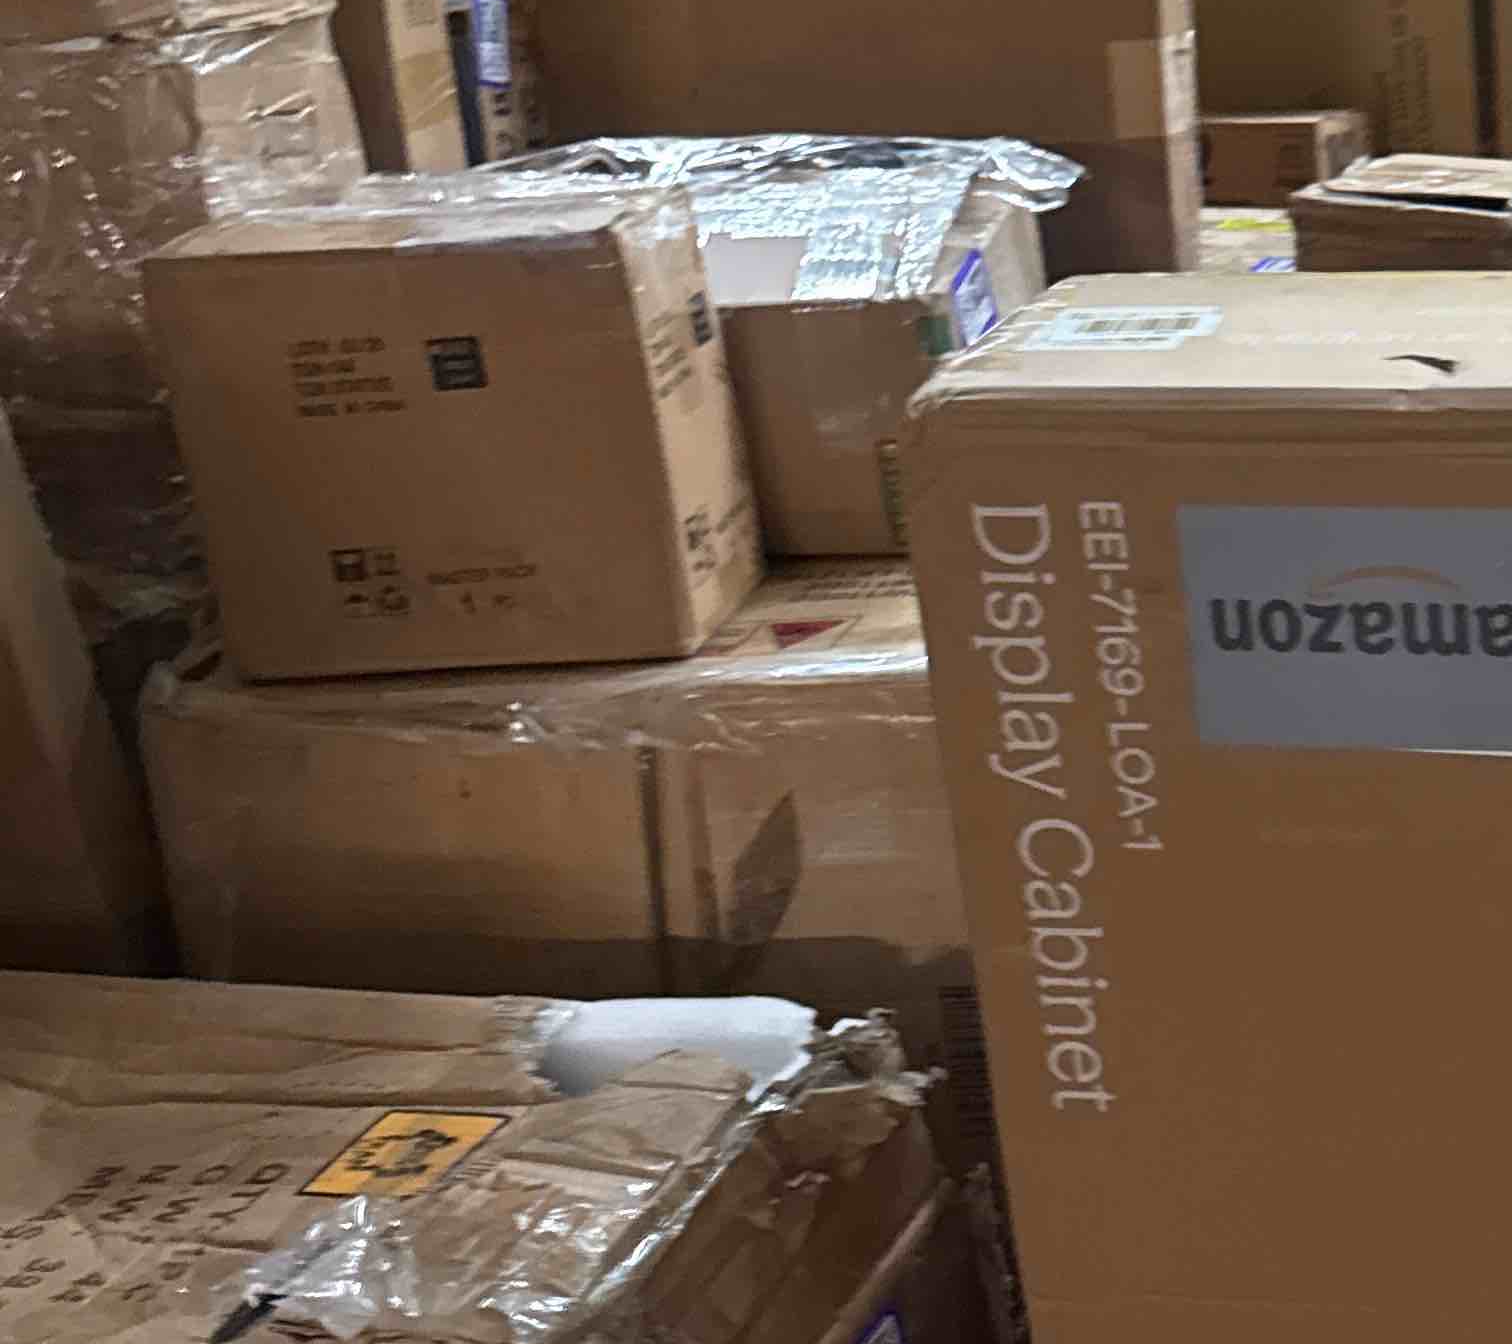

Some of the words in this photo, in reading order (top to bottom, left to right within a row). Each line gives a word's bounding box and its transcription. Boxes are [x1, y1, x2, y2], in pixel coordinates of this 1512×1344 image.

[970, 502, 1076, 801] Display
[1078, 499, 1165, 852] EEI-7169-LOA-1
[1015, 816, 1118, 1113] Cabinet
